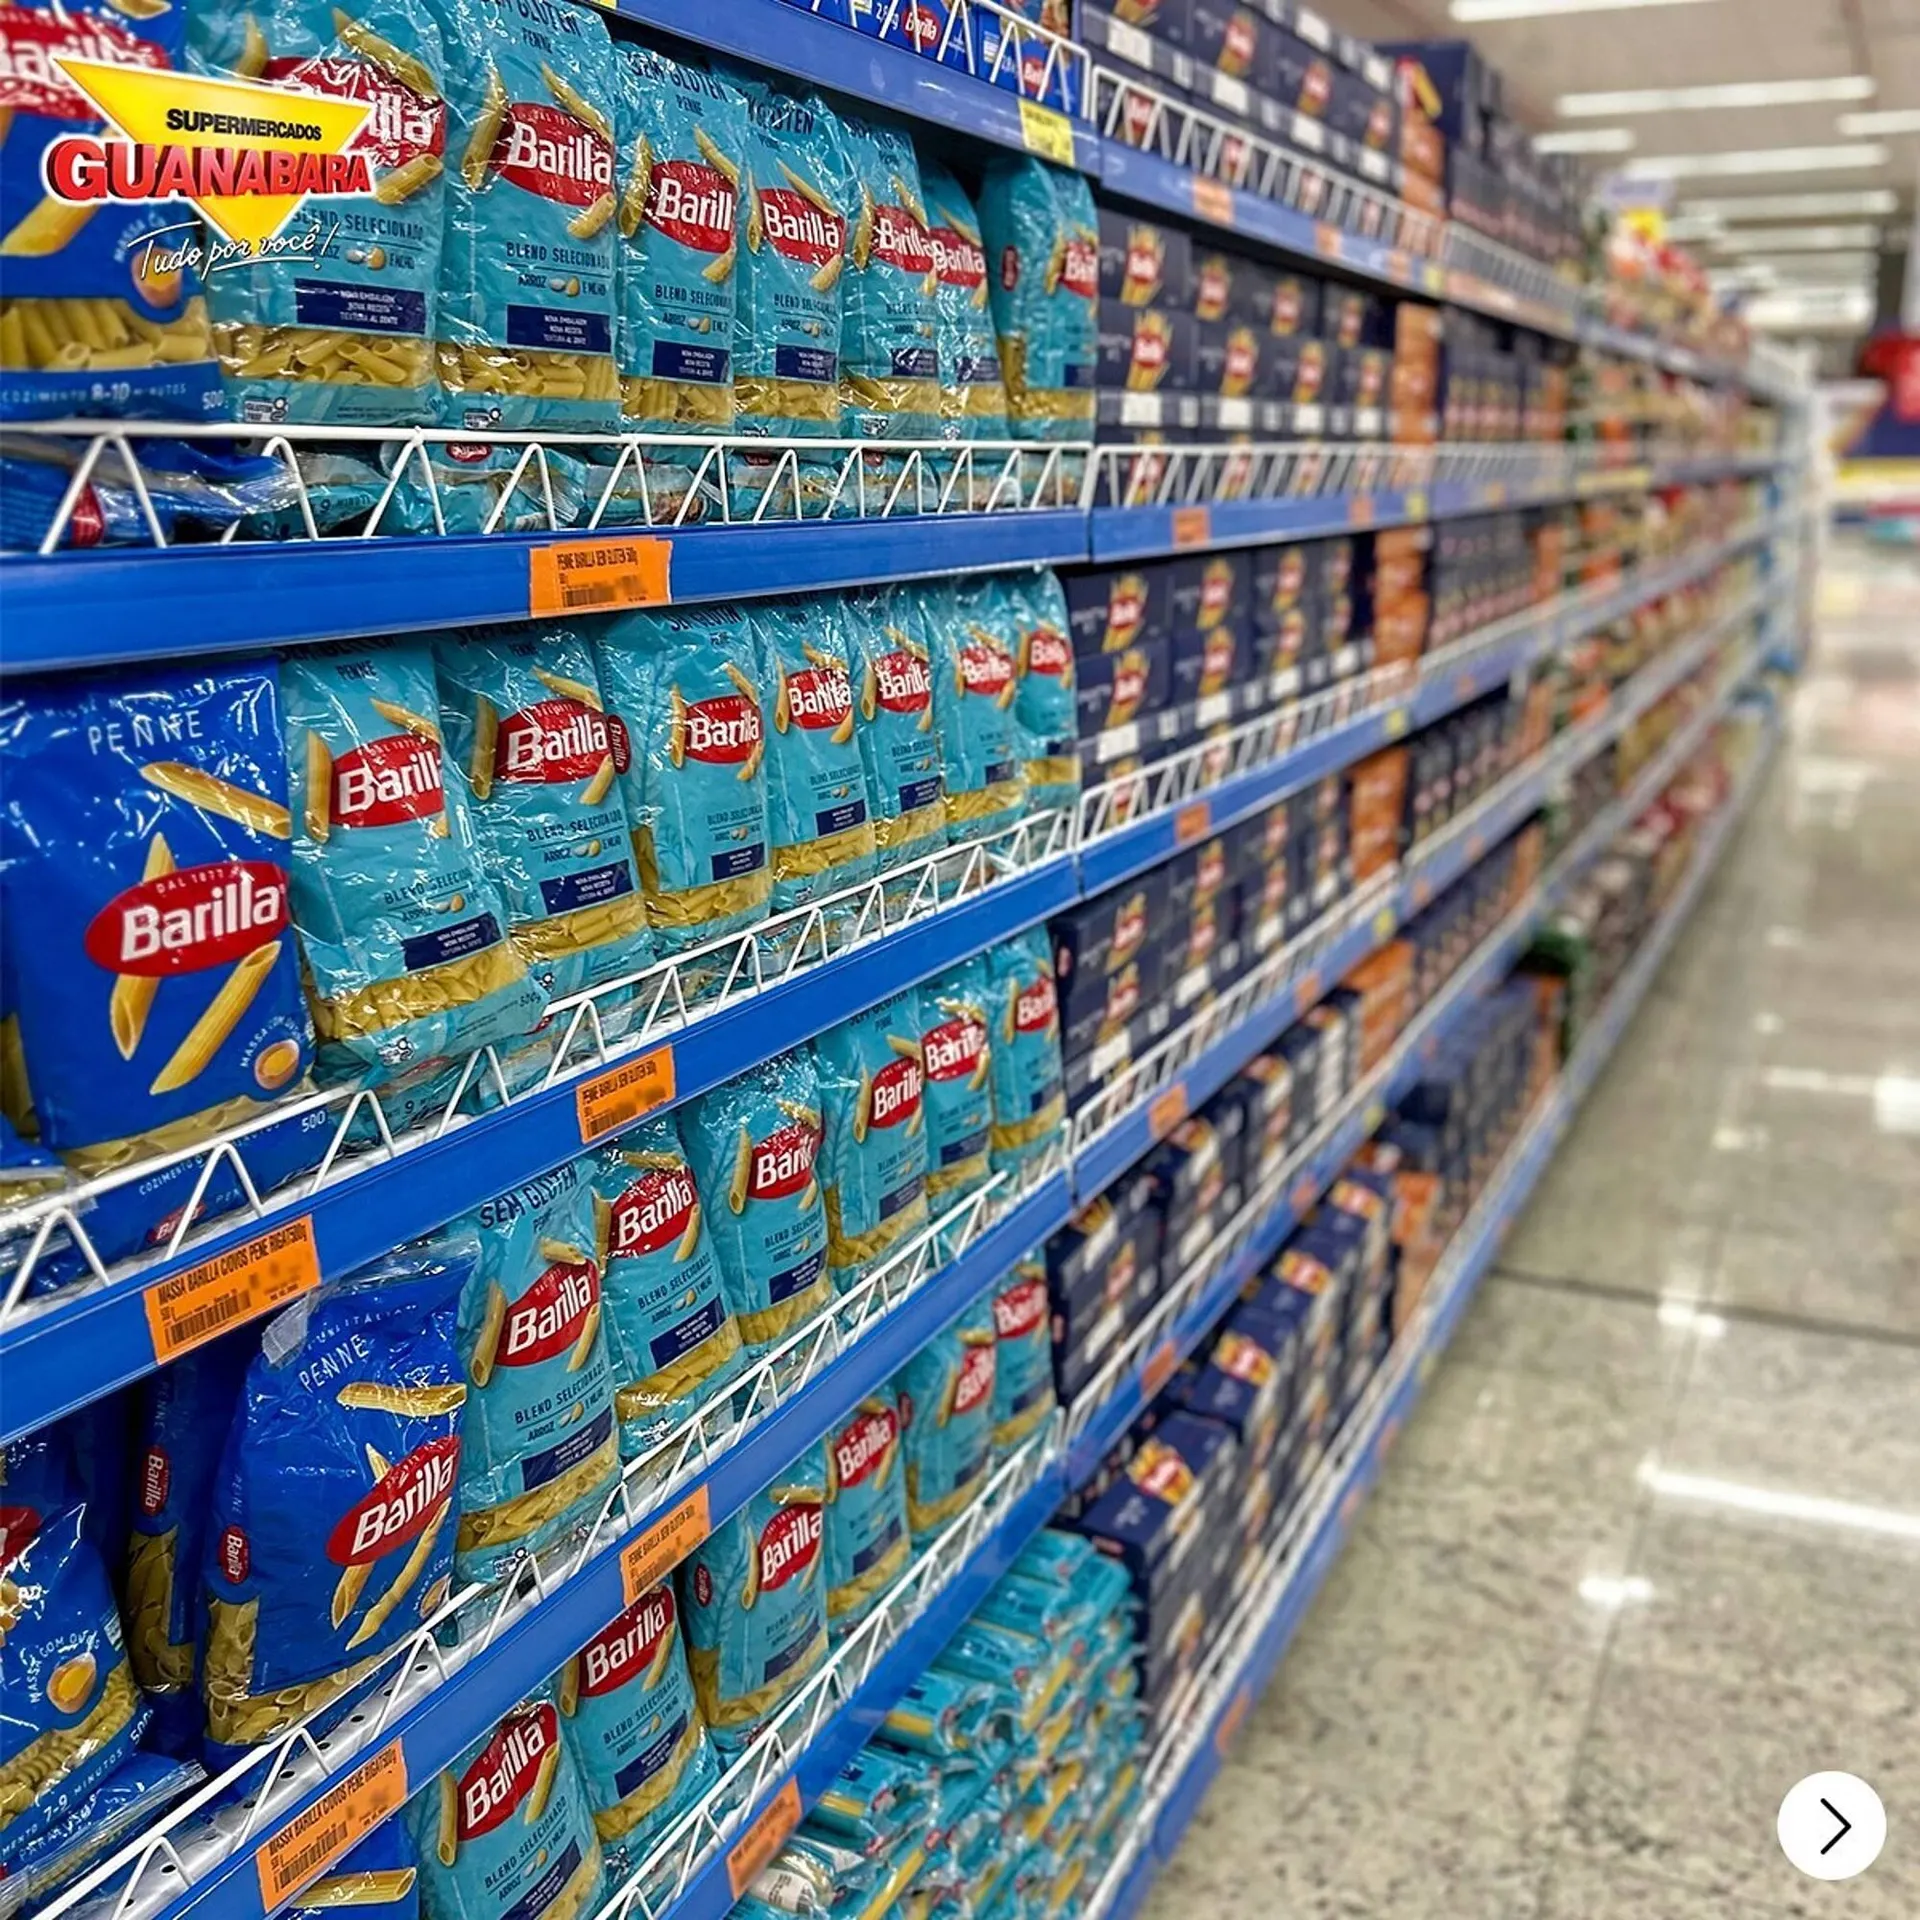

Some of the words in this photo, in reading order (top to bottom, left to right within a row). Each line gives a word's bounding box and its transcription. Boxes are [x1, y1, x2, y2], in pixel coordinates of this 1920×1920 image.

[905, 13, 937, 41] Brilla
[671, 67, 730, 103] GLUTEN
[507, 121, 612, 186] Barilla
[656, 177, 733, 232] Barill
[764, 203, 840, 248] Barilla
[506, 242, 548, 261] BLEND
[879, 217, 932, 258] Barilla
[655, 284, 688, 302] BLEND
[89, 709, 204, 756] PENNE
[508, 713, 609, 771] Barilla
[338, 749, 442, 816] Barill
[156, 880, 178, 896] DAL
[121, 881, 280, 963] Barilla
[302, 1109, 327, 1133] 500
[479, 1189, 524, 1229] SEM
[618, 1178, 693, 1249] Barilla
[157, 1279, 186, 1306] MASSA
[187, 1263, 220, 1292] BARILLA
[249, 1238, 270, 1263] PENE
[637, 1284, 669, 1310] BLEND
[507, 1274, 593, 1357] Barilla
[300, 1334, 370, 1395] PENNE
[515, 1398, 552, 1425] BLEND
[145, 1453, 164, 1510] Barilla
[352, 1453, 455, 1557] Barilla
[762, 1509, 824, 1585] Barilla
[585, 1603, 667, 1689] Barilla
[603, 1716, 634, 1745] BLEND
[43, 1794, 68, 1823] 7-9
[73, 1749, 124, 1796] MINUTOS
[465, 1719, 546, 1830] Barilla
[484, 1855, 519, 1889] BLEND
